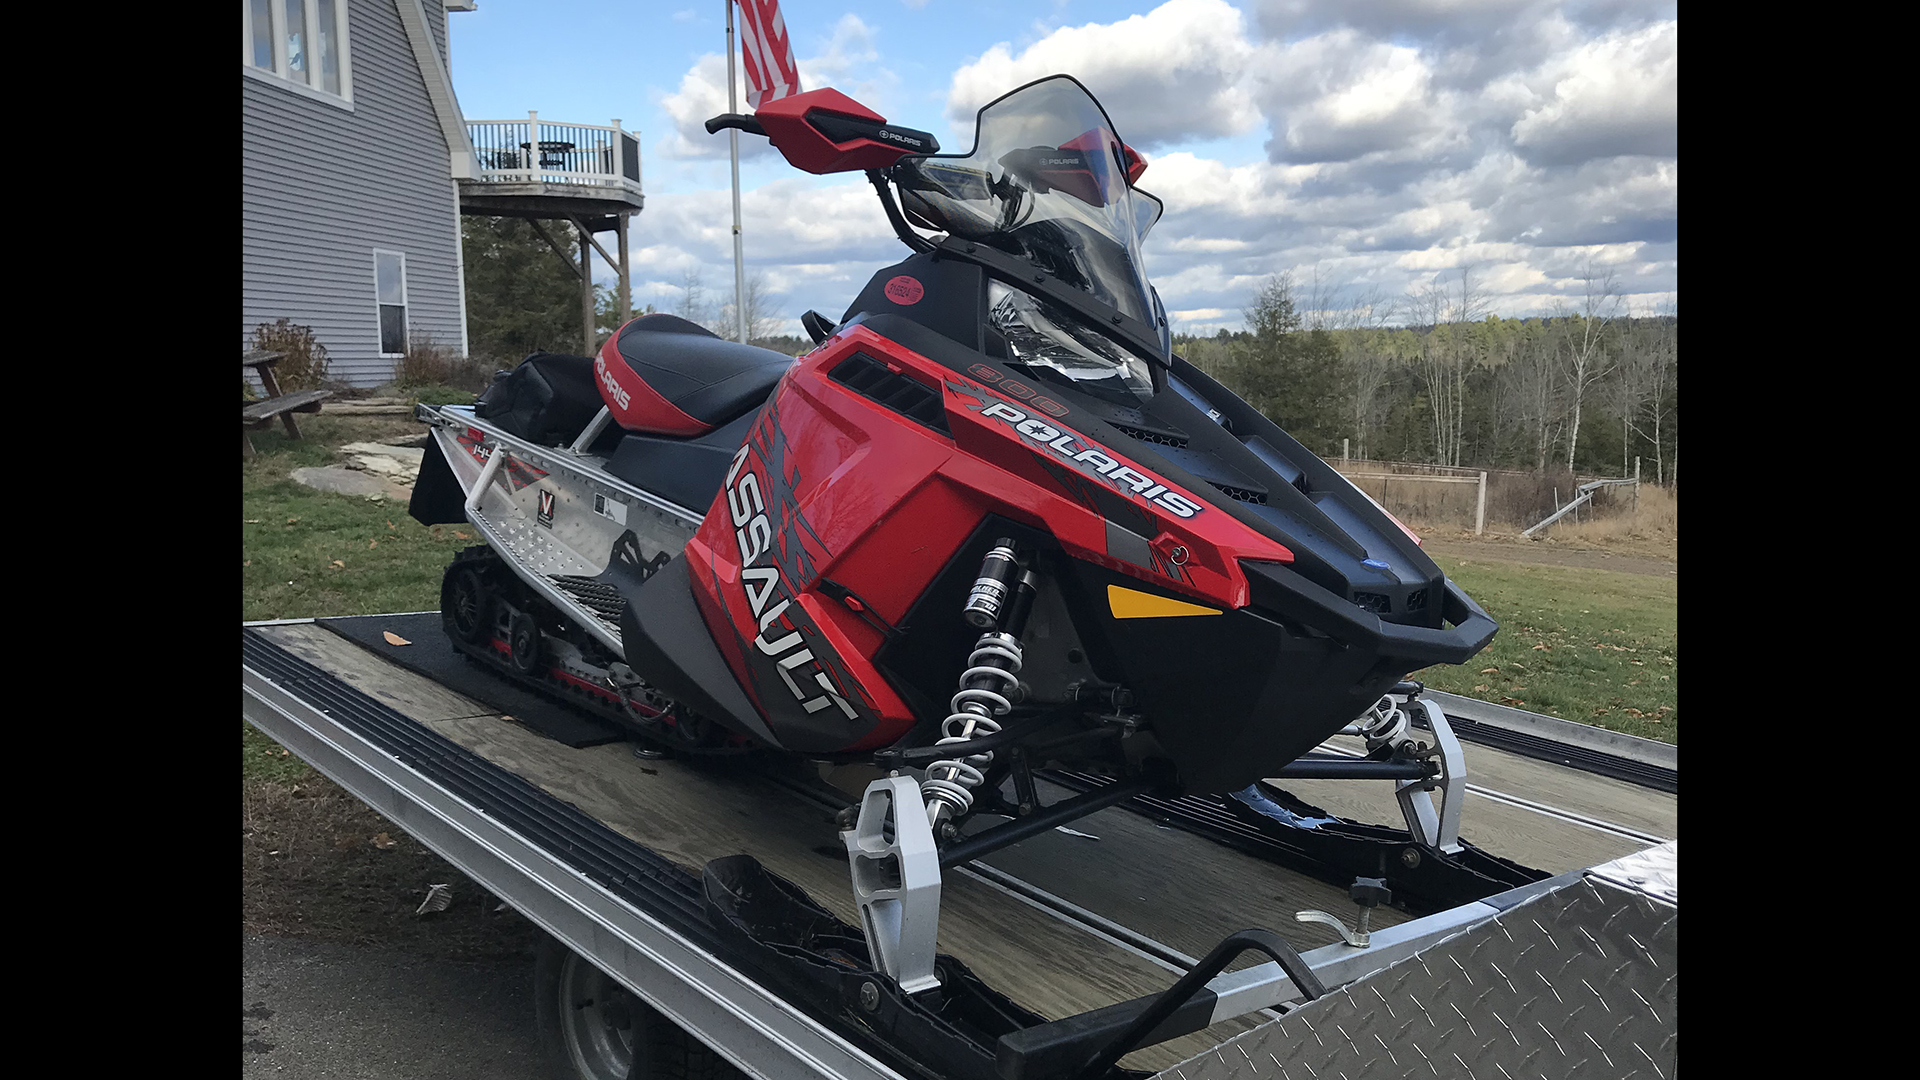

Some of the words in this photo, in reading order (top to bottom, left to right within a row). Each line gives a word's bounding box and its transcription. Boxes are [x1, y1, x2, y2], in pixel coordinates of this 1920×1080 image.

[889, 132, 922, 147] POLARIS
[1048, 157, 1080, 165] POLARIS
[595, 349, 632, 411] POLARIS
[967, 363, 1070, 418] 800
[980, 401, 1204, 519] POLARIS
[725, 443, 859, 720] ASSAULT
